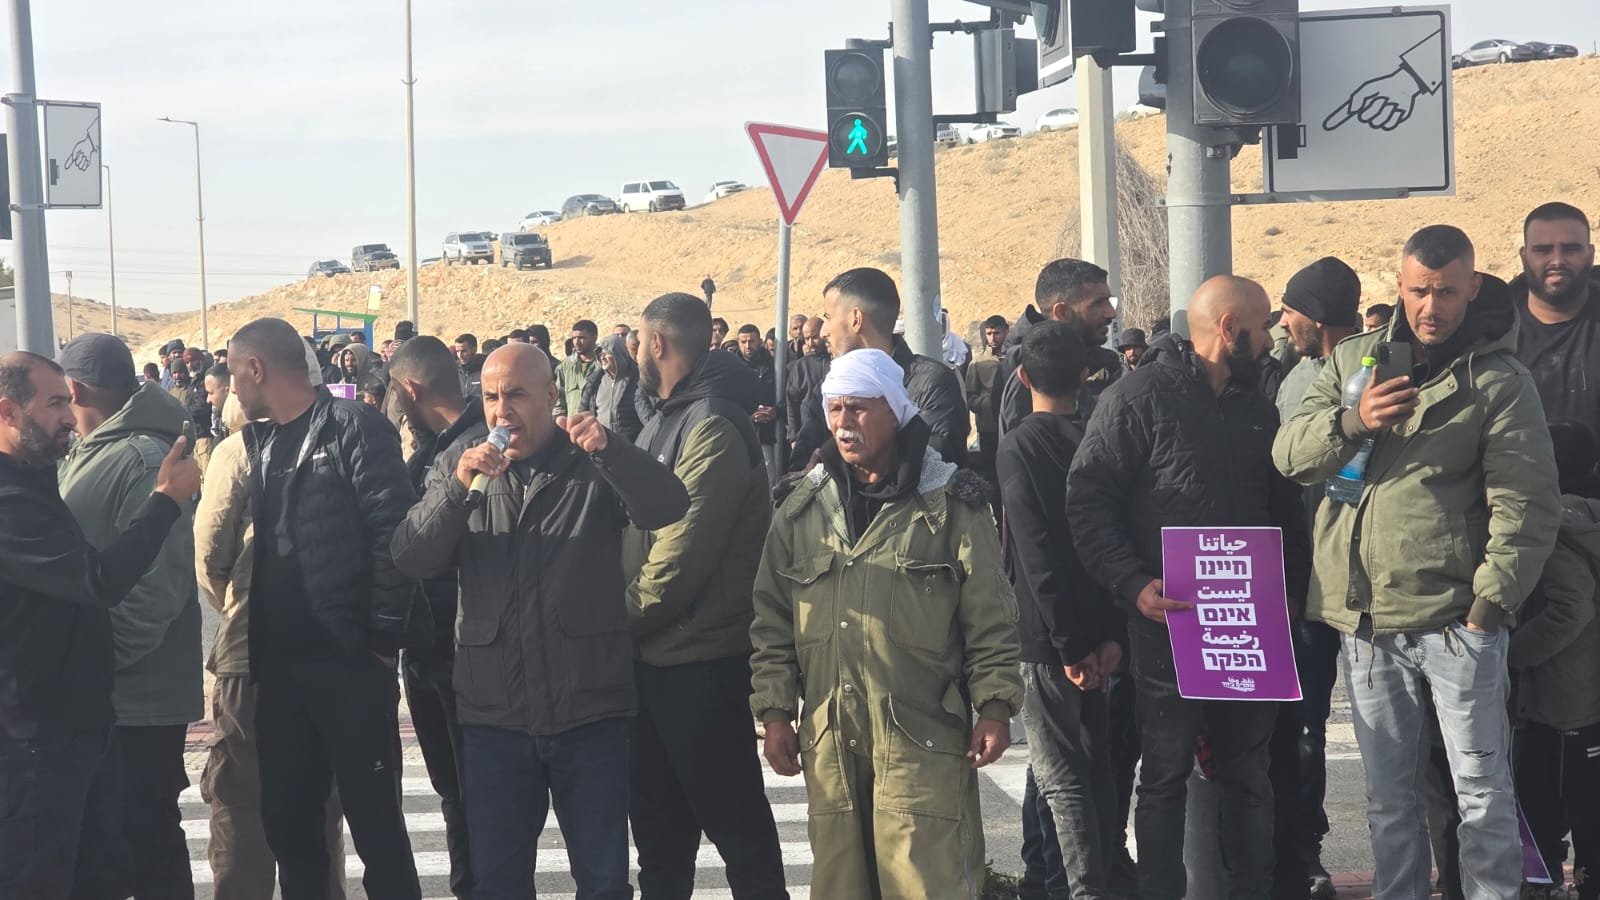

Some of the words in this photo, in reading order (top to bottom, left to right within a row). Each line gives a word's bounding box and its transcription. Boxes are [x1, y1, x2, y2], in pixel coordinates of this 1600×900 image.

[1199, 533, 1248, 555] حياتنا
[1200, 560, 1247, 575] חיינו
[1197, 581, 1251, 602] ليست
[1204, 607, 1251, 622] אינם
[1202, 627, 1259, 649] رخيصة
[1206, 652, 1262, 669] הפקר
